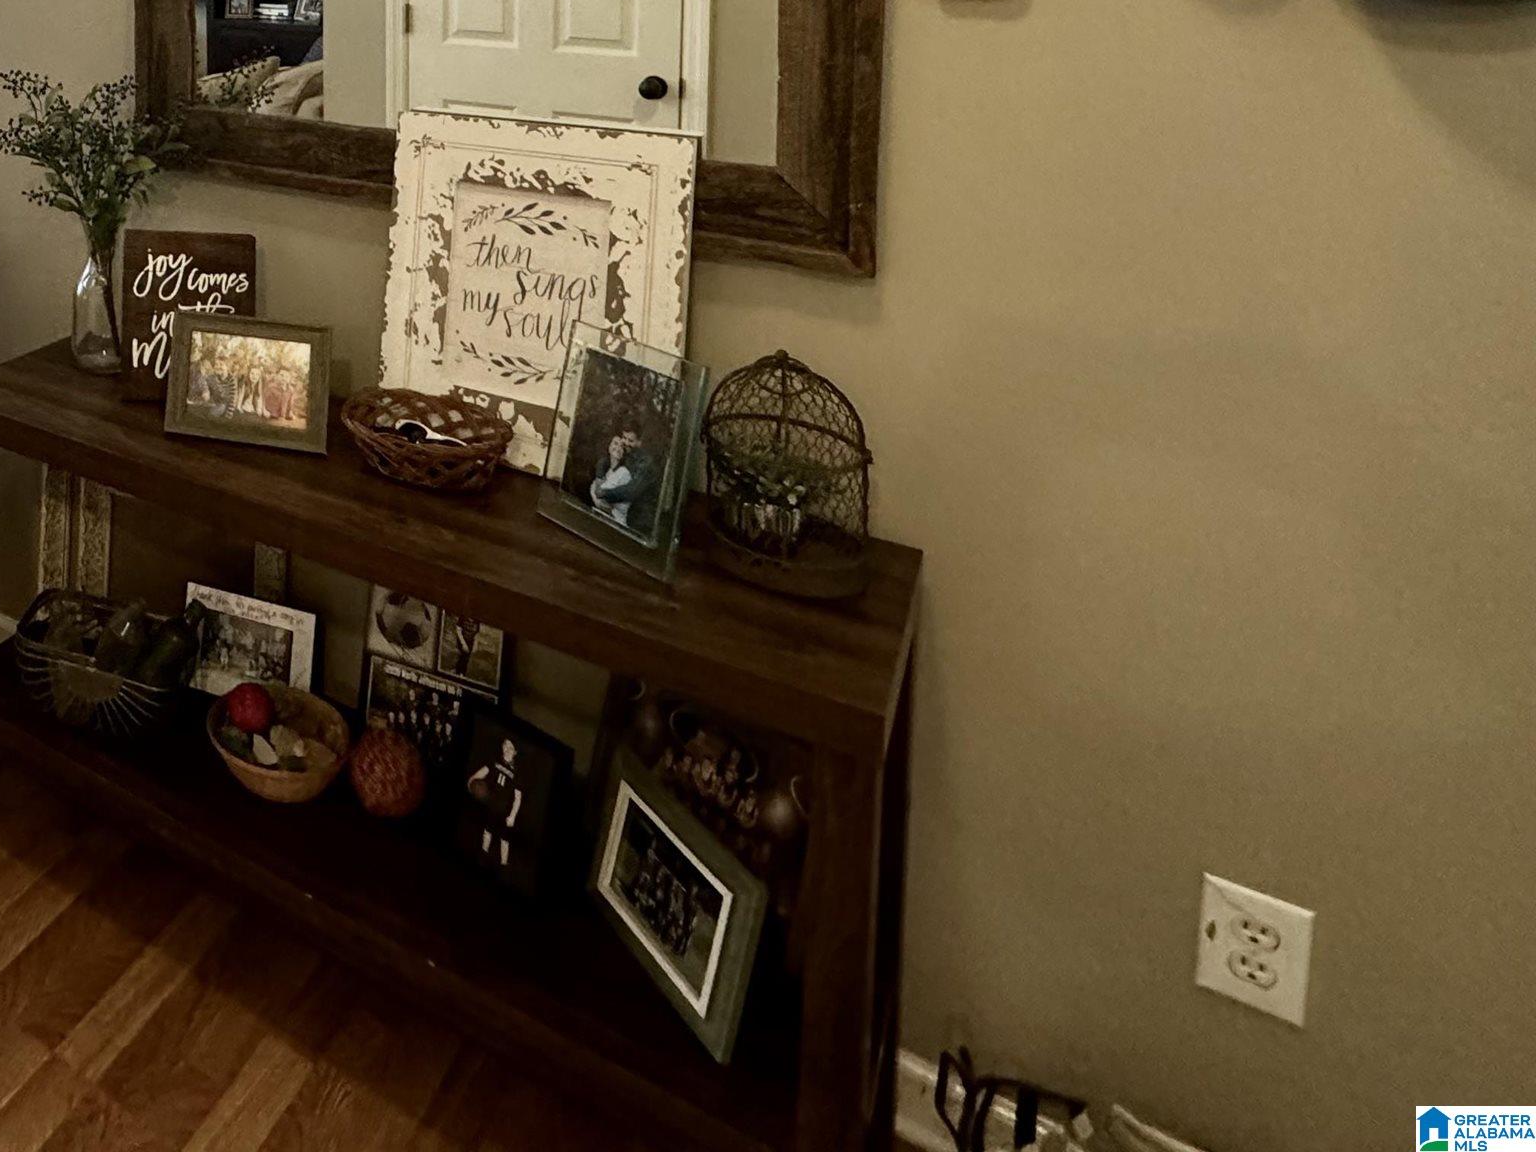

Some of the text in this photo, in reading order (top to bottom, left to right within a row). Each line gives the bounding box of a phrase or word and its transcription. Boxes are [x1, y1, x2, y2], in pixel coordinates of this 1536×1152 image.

[133, 249, 250, 301] joy comes
[466, 234, 547, 274] then
[151, 310, 176, 337] in
[463, 289, 572, 351] my soul
